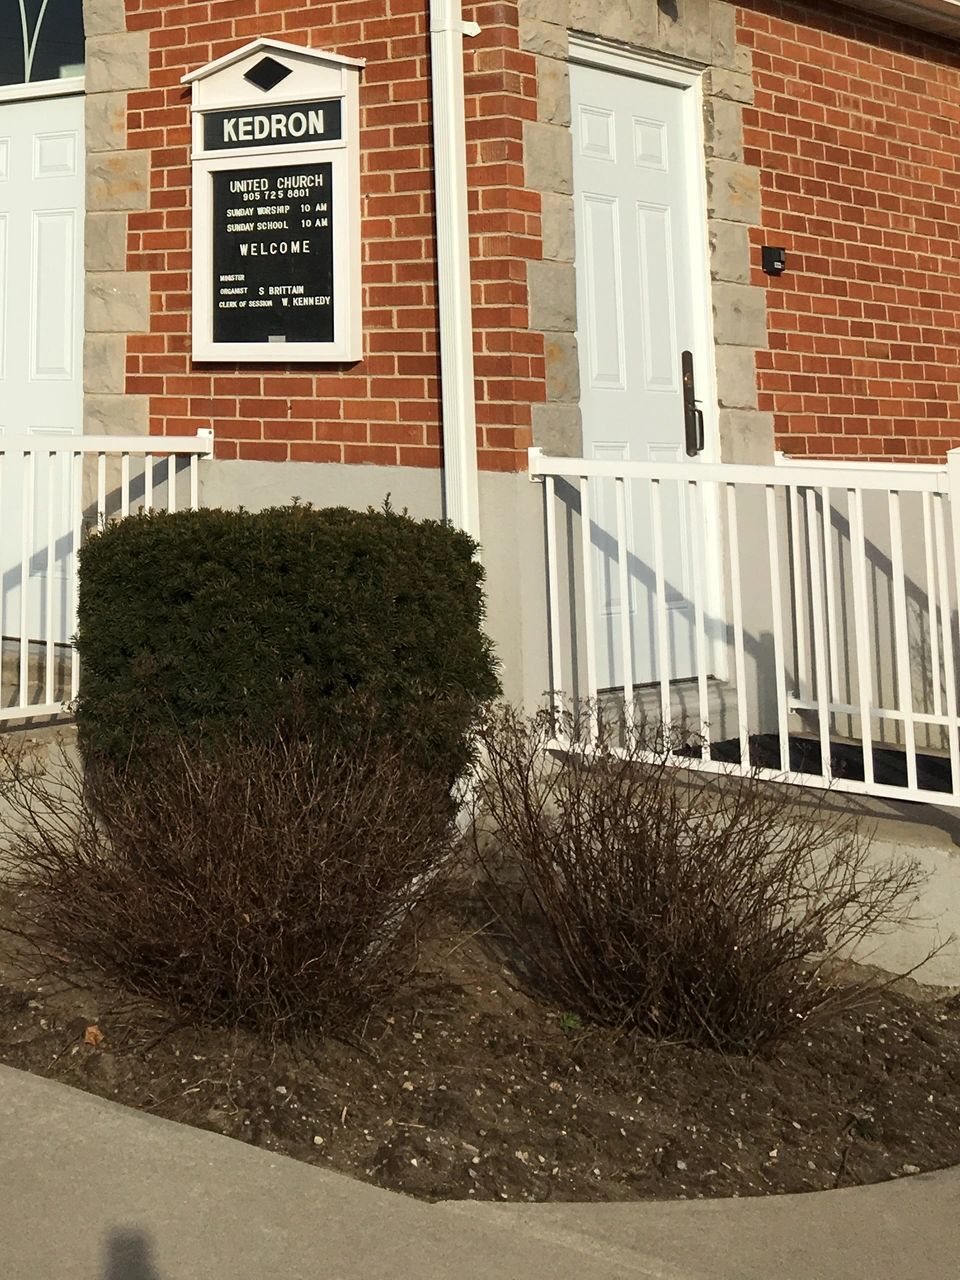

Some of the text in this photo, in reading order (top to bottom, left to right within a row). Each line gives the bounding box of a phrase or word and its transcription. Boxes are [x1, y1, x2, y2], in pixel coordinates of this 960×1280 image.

[223, 109, 324, 143] KEDRON
[230, 174, 323, 193] UNITED CHURCH
[242, 192, 261, 201] 905
[287, 188, 310, 198] 8801
[226, 203, 328, 217] SUNDAY WORSHIP 10 AM
[226, 218, 328, 232] SUNDAY SCHOOL 10 AM
[240, 240, 310, 256] WELCOME
[258, 287, 265, 296] S
[268, 285, 304, 295] BRITTAIN
[238, 300, 247, 308] OF
[292, 296, 331, 306] KENNEDY
